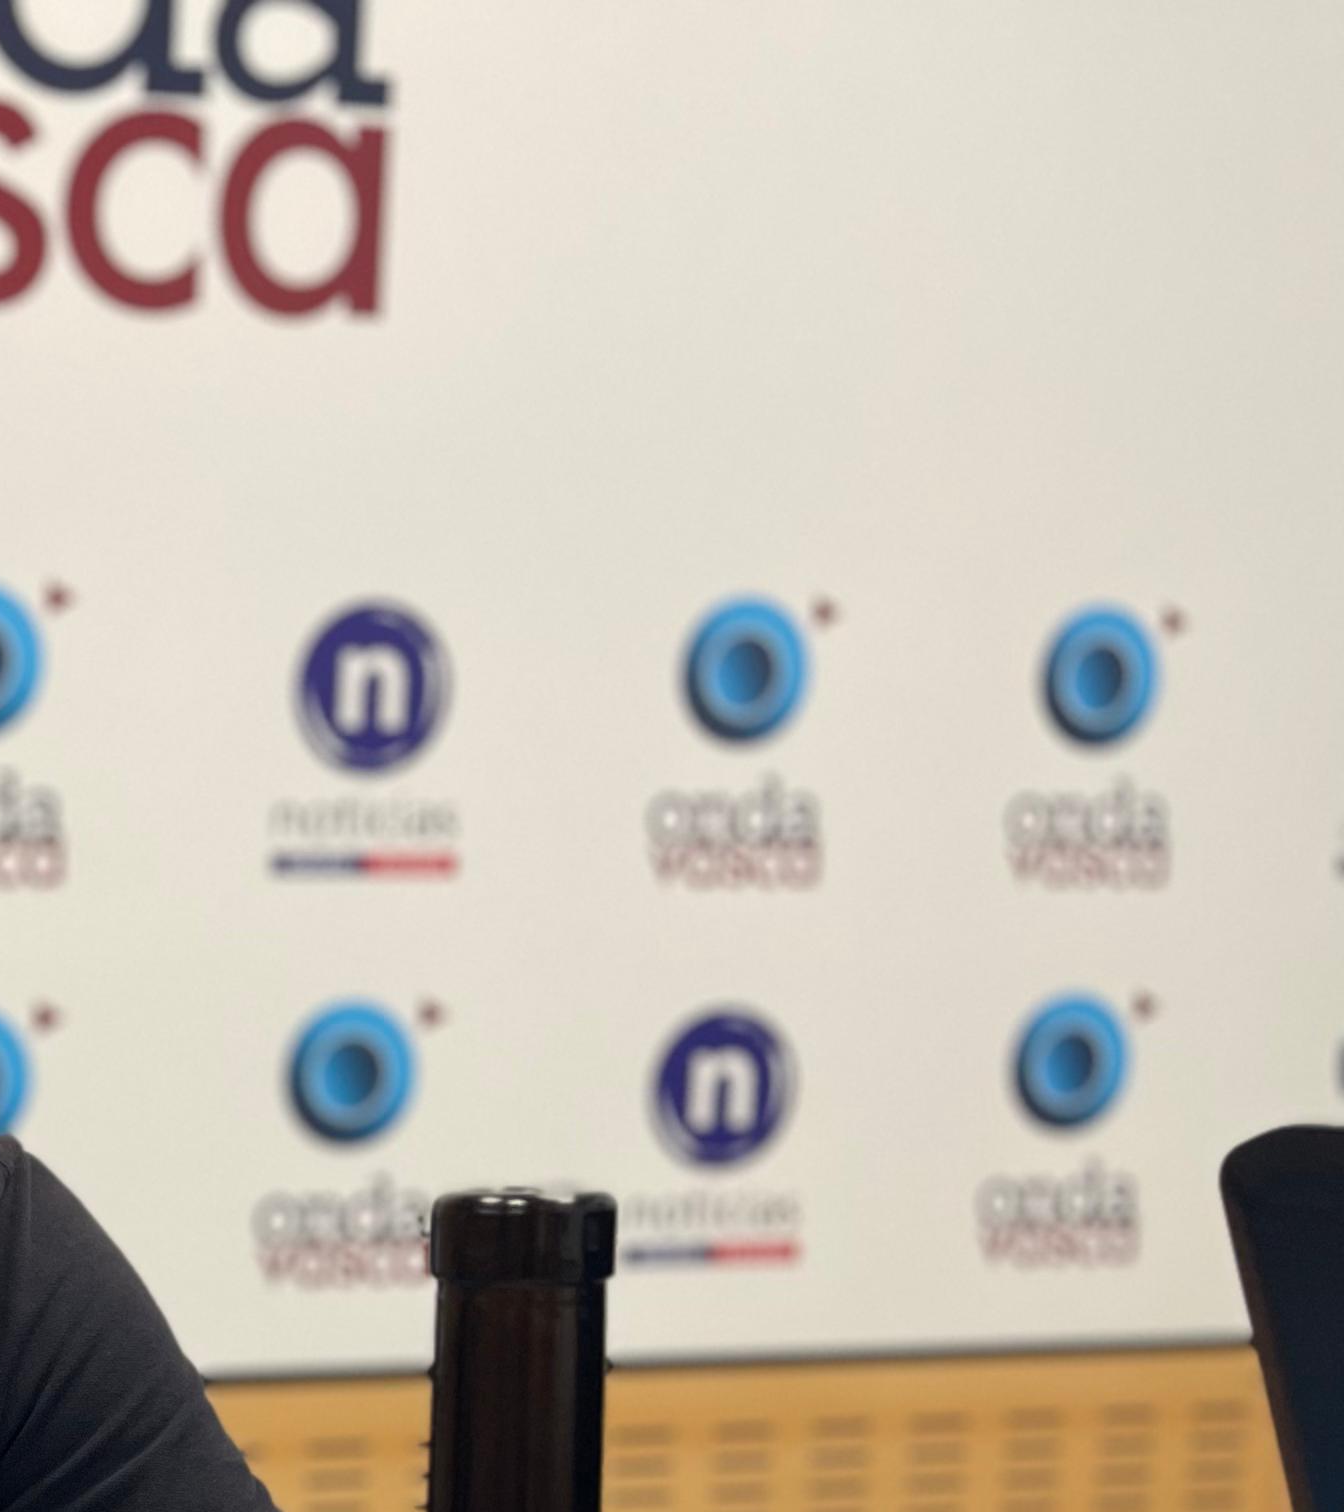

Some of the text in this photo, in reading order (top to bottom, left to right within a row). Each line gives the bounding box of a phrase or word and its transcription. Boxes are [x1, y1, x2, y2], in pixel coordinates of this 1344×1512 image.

[645, 771, 823, 849] onda
[1002, 775, 1170, 849] onda
[973, 1160, 1139, 1231] onda
